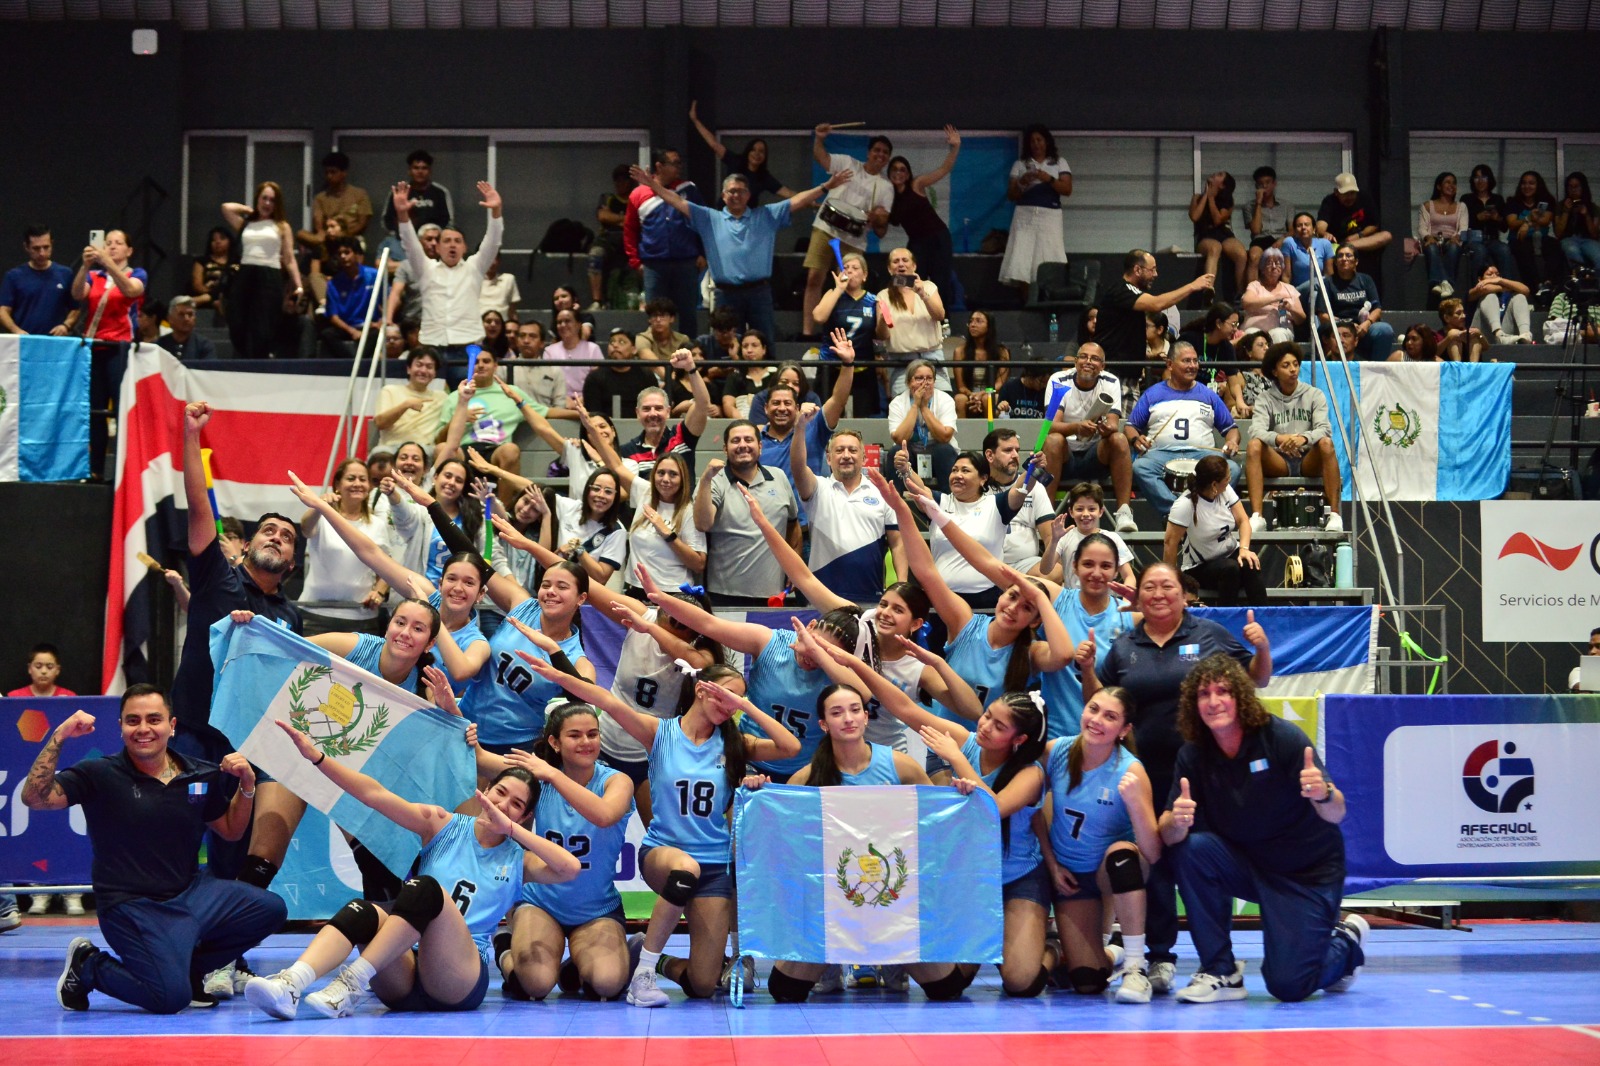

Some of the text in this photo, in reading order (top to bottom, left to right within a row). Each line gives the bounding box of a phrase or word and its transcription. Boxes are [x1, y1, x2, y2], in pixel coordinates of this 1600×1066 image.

[846, 316, 863, 338] 7
[1011, 407, 1044, 419] OBOTS
[1174, 418, 1189, 440] 9
[1218, 525, 1230, 543] 2
[1500, 593, 1563, 606] Servicios
[1568, 594, 1586, 606] de
[496, 651, 533, 696] 10
[635, 677, 658, 709] 8
[771, 704, 811, 739] 15
[674, 779, 716, 818] 18
[1064, 807, 1085, 840] 7
[1460, 822, 1537, 835] AFECAVOL
[451, 878, 477, 916] 6
